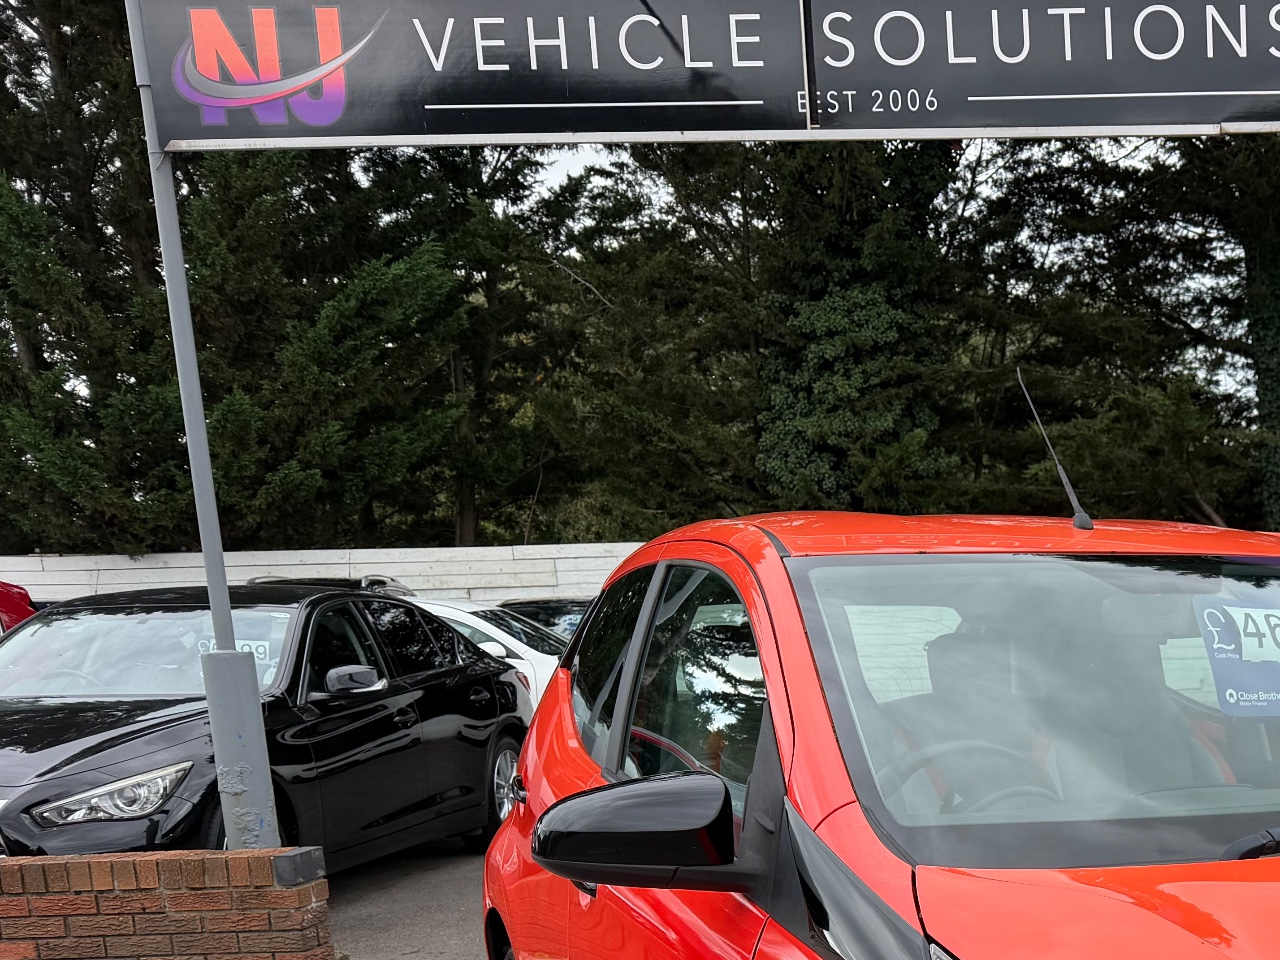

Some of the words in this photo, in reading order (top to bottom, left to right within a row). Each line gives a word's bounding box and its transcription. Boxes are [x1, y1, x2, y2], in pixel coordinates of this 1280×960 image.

[412, 13, 762, 72] VEHICLE
[187, 5, 346, 127] NJ
[871, 88, 938, 112] 2006
[1238, 691, 1258, 700] Close
